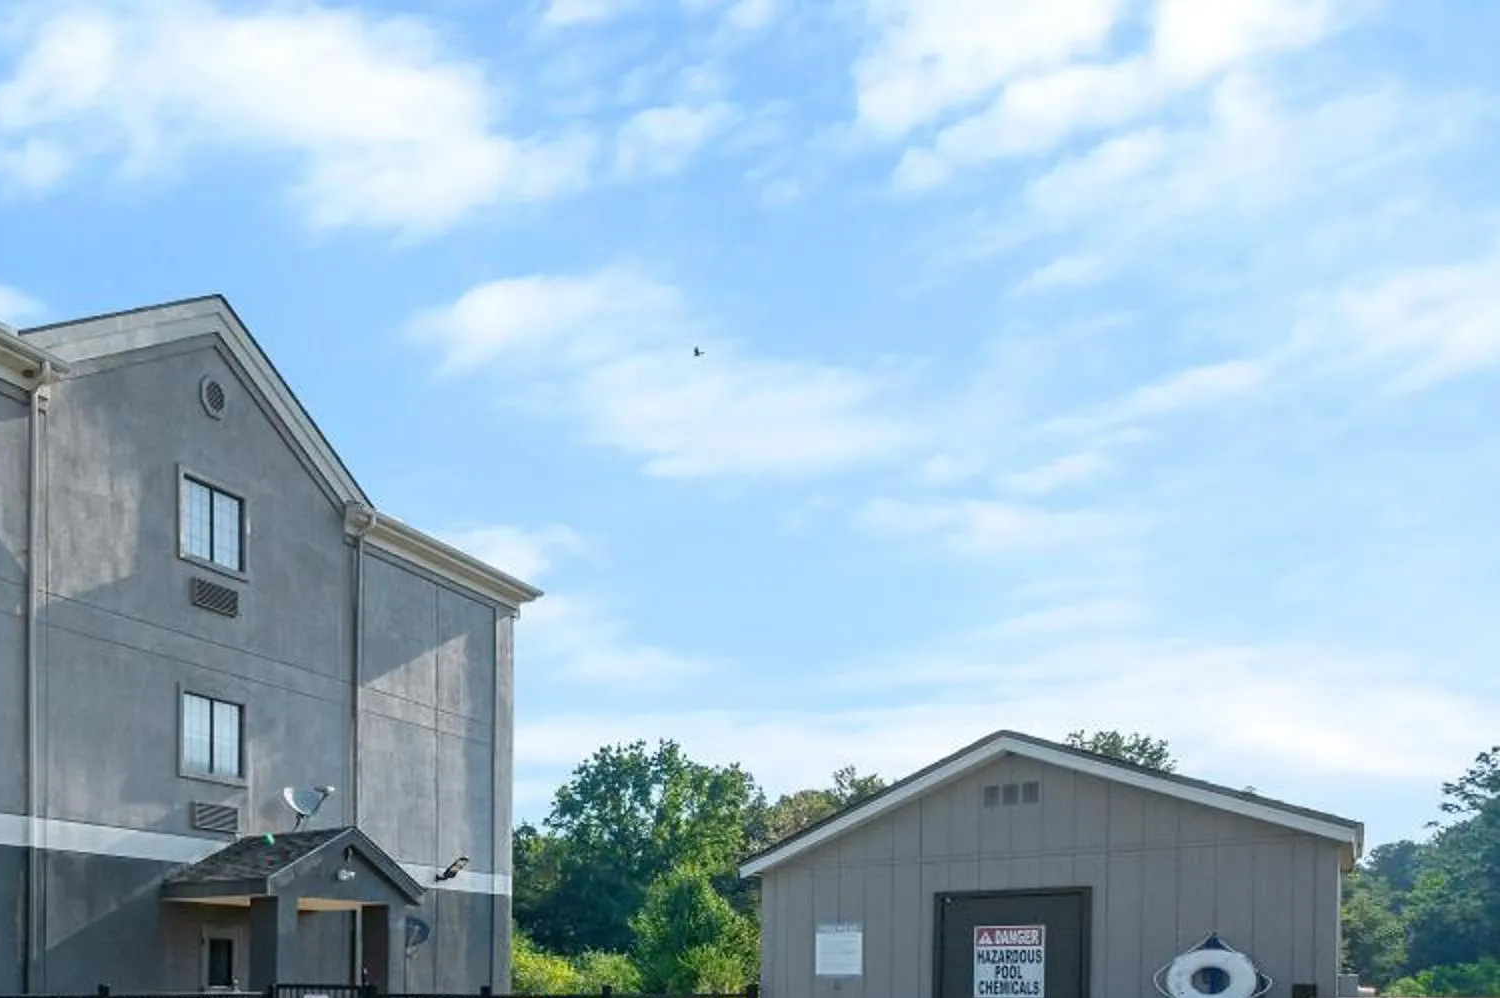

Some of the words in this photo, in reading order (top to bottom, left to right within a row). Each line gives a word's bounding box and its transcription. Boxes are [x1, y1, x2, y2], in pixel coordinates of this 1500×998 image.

[995, 930, 1039, 945] DANGER
[978, 949, 1042, 964] HAZARDOUS
[995, 965, 1023, 979] POOL
[979, 980, 1040, 995] CHEMICALS
